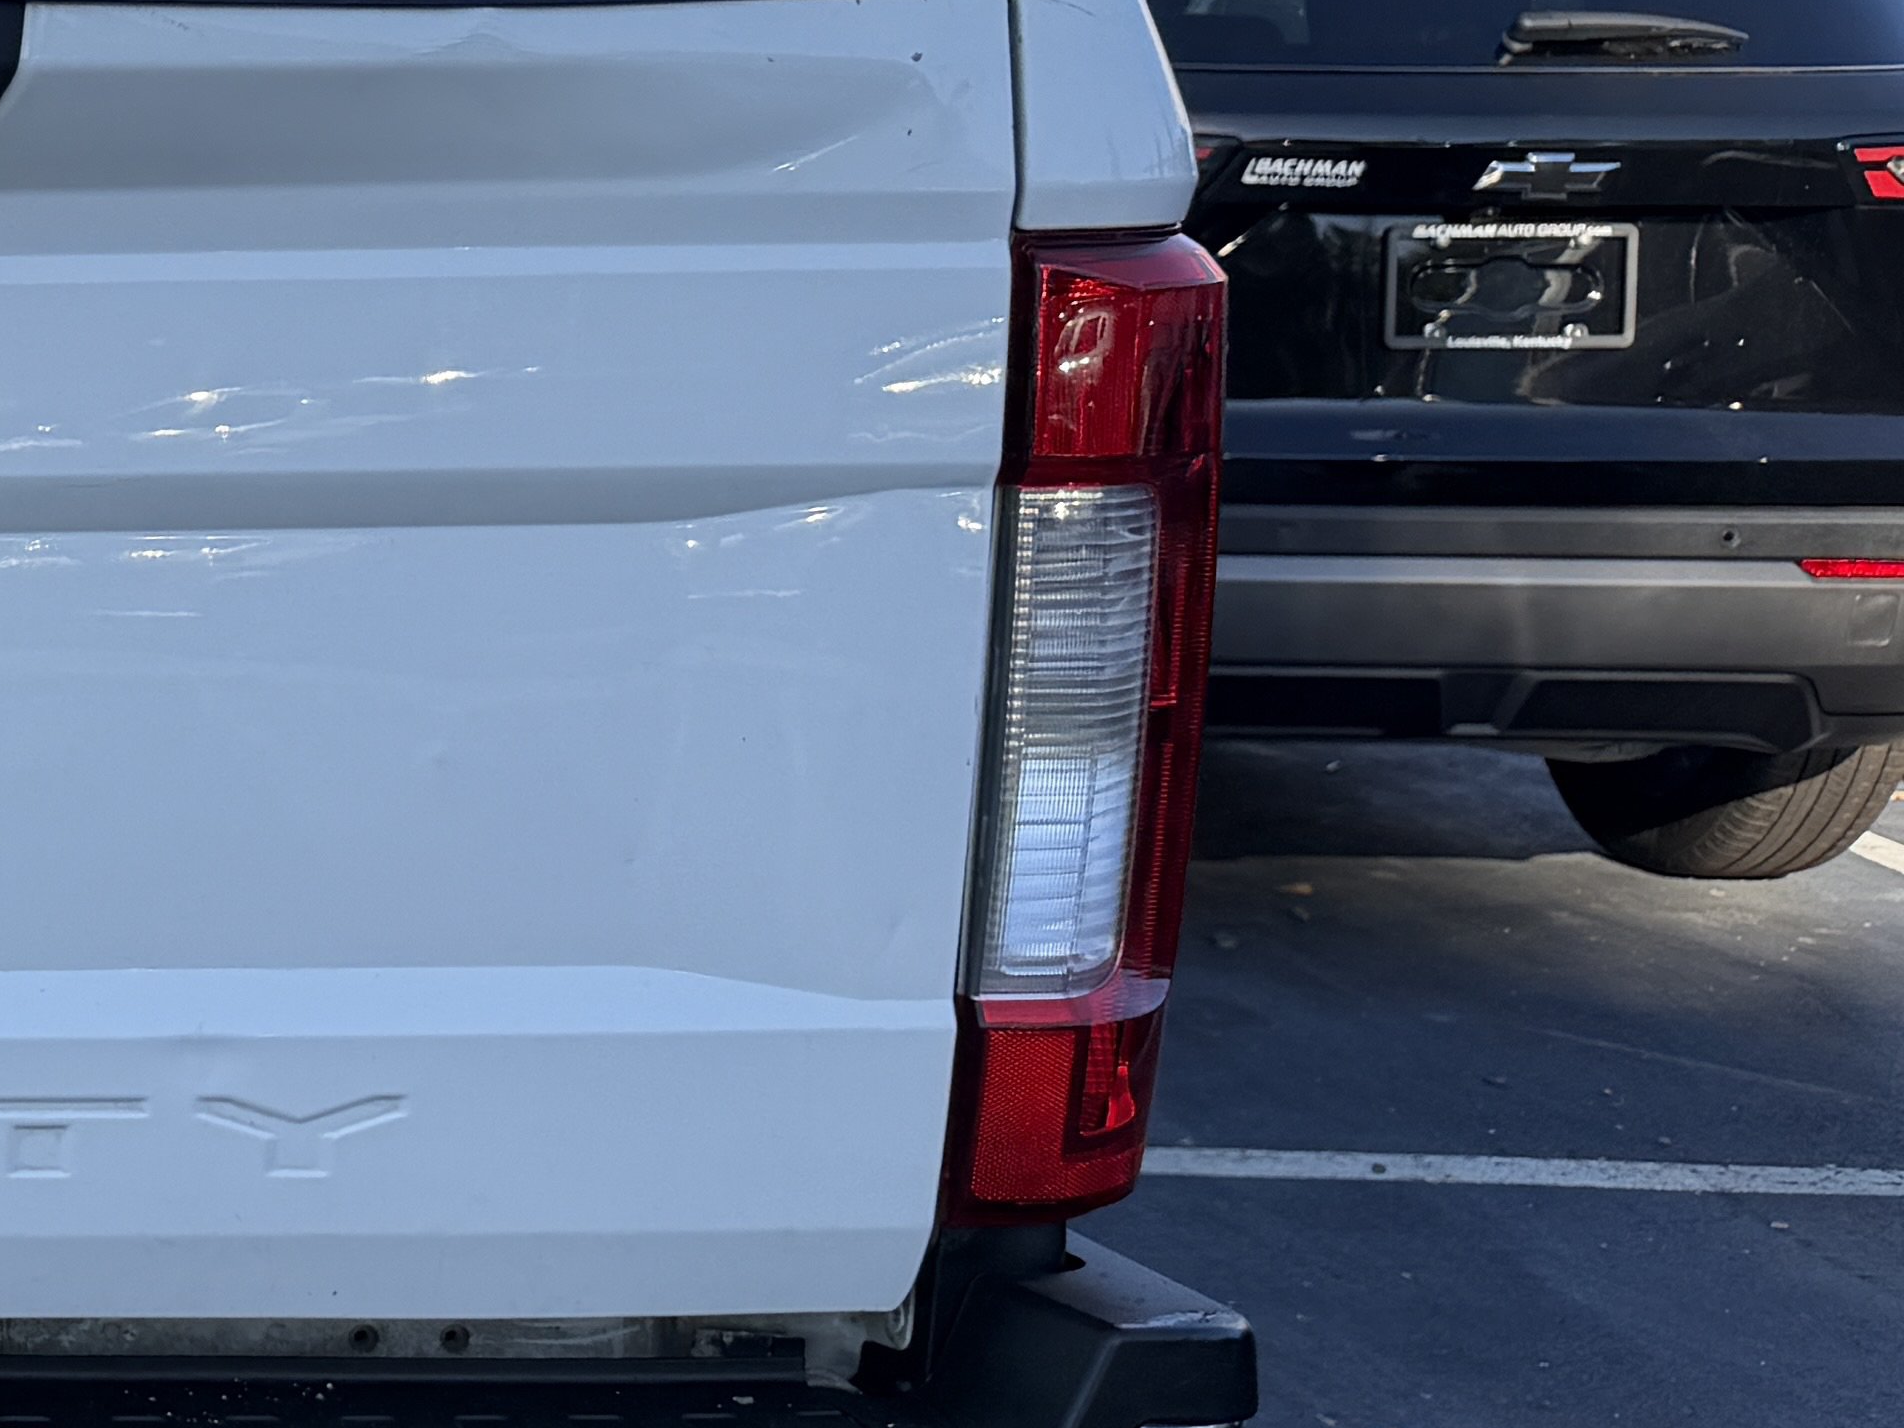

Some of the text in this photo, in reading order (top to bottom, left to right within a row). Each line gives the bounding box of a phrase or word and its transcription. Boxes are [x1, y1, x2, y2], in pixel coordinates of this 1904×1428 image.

[1254, 157, 1366, 177] BACHMAN
[1497, 223, 1535, 237] AUTO
[1512, 335, 1572, 349] Kentucky
